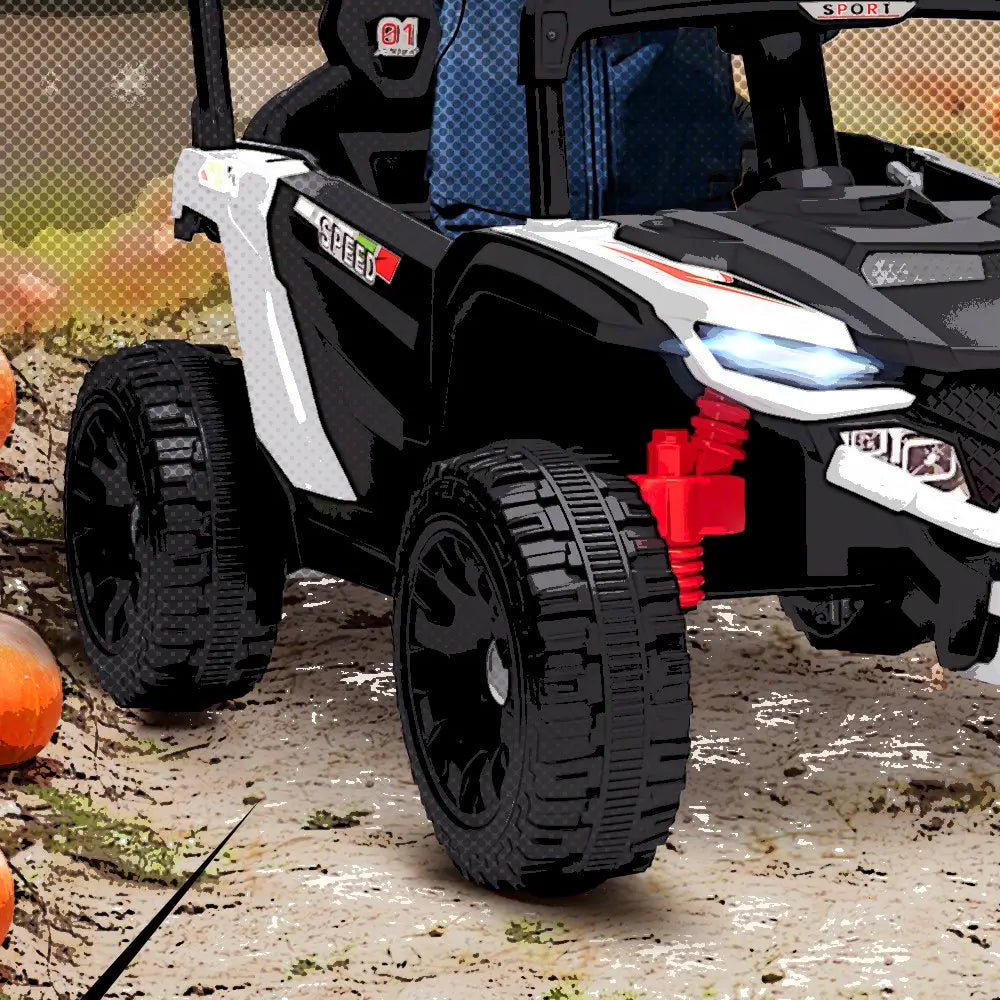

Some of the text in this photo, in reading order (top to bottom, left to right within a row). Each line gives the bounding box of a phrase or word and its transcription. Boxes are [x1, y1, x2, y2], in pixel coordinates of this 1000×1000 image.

[822, 2, 891, 16] SPORT
[381, 22, 416, 46] 01
[319, 215, 377, 284] SPEED
